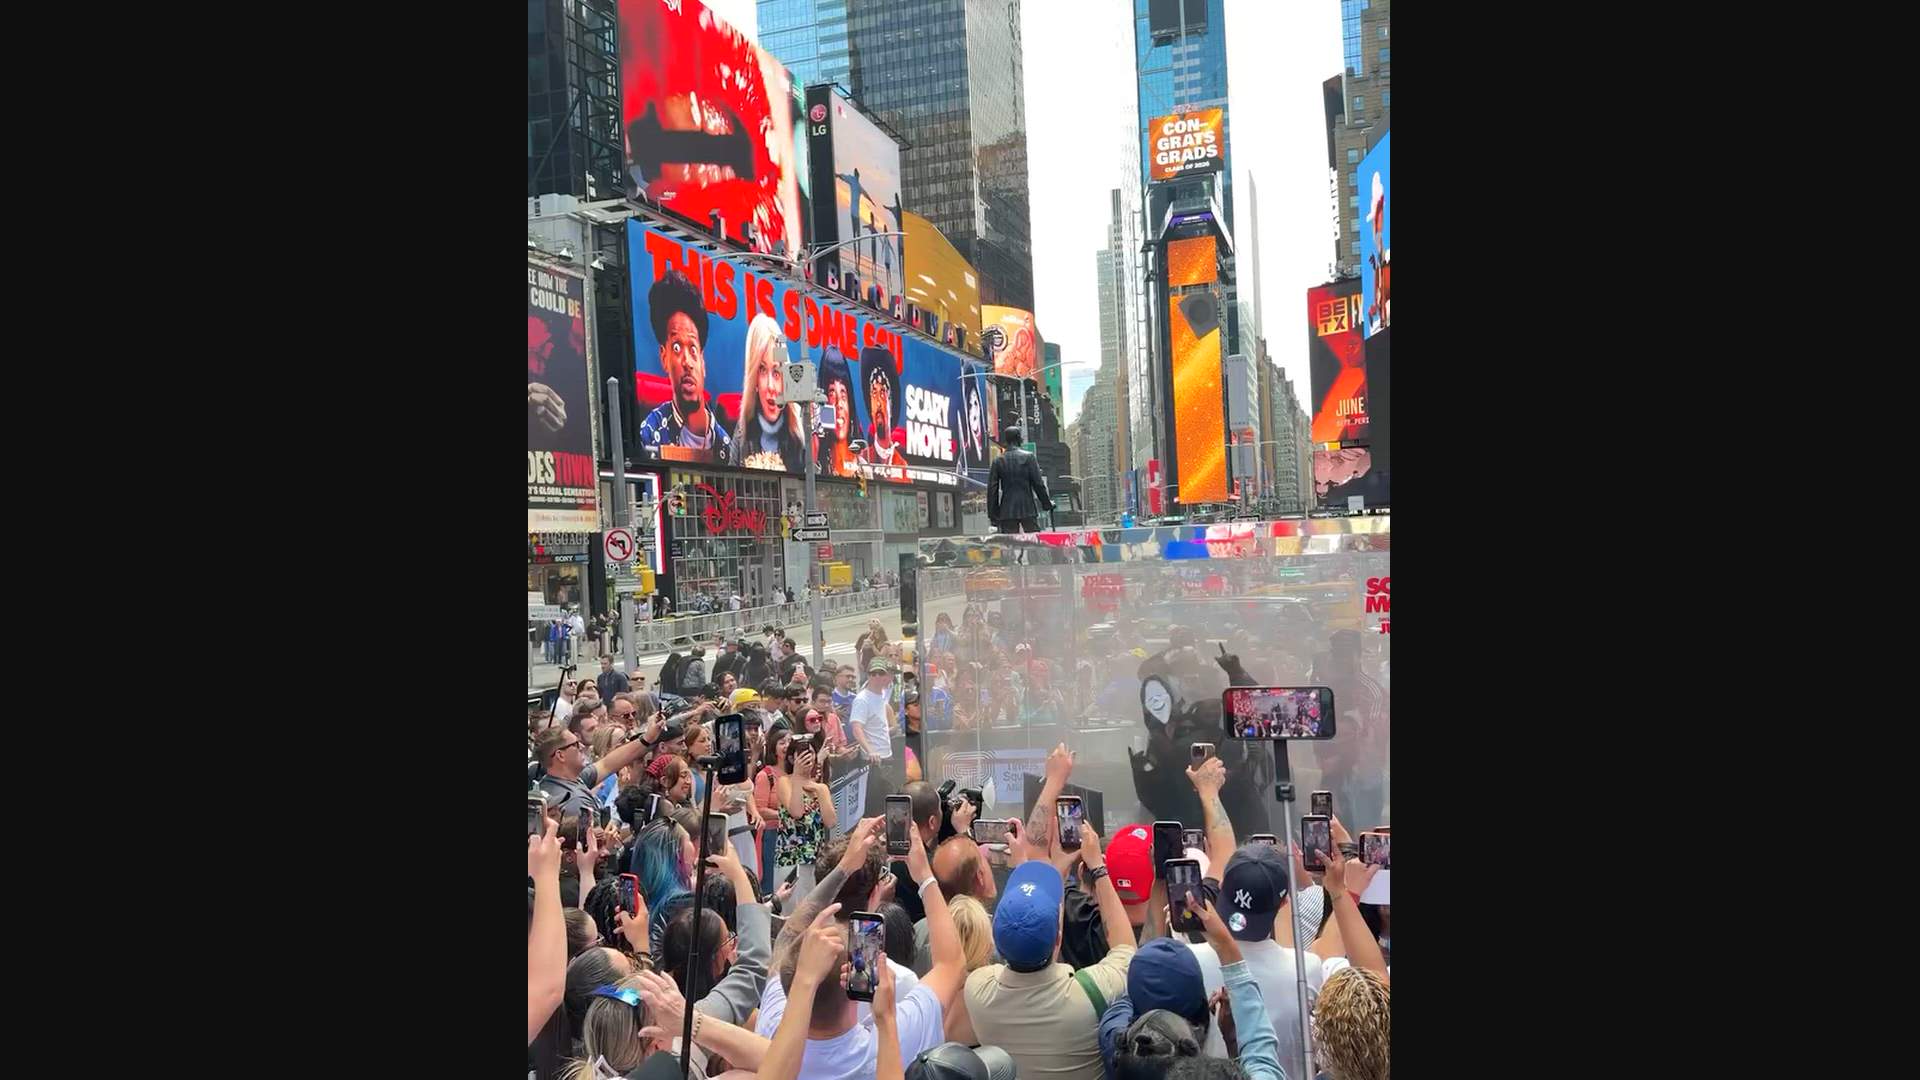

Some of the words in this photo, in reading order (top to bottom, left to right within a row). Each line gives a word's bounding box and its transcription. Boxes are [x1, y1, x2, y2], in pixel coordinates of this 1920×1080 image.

[812, 125, 827, 136] LG
[1163, 118, 1208, 136] CON-
[1156, 131, 1216, 151] GRATS
[1156, 144, 1218, 165] GRADS
[530, 286, 567, 314] COULD
[567, 298, 582, 319] BE
[644, 230, 738, 321] THIS
[743, 271, 777, 326] IS
[783, 288, 860, 362] SOME
[827, 261, 968, 350] BROADWAY
[904, 384, 951, 428] SCARY
[1335, 396, 1366, 417] JUNE
[905, 419, 954, 462] MOVIE
[538, 486, 563, 496] GLOBAL
[539, 531, 590, 545] LUGGAGE
[1233, 888, 1253, 909] NY
